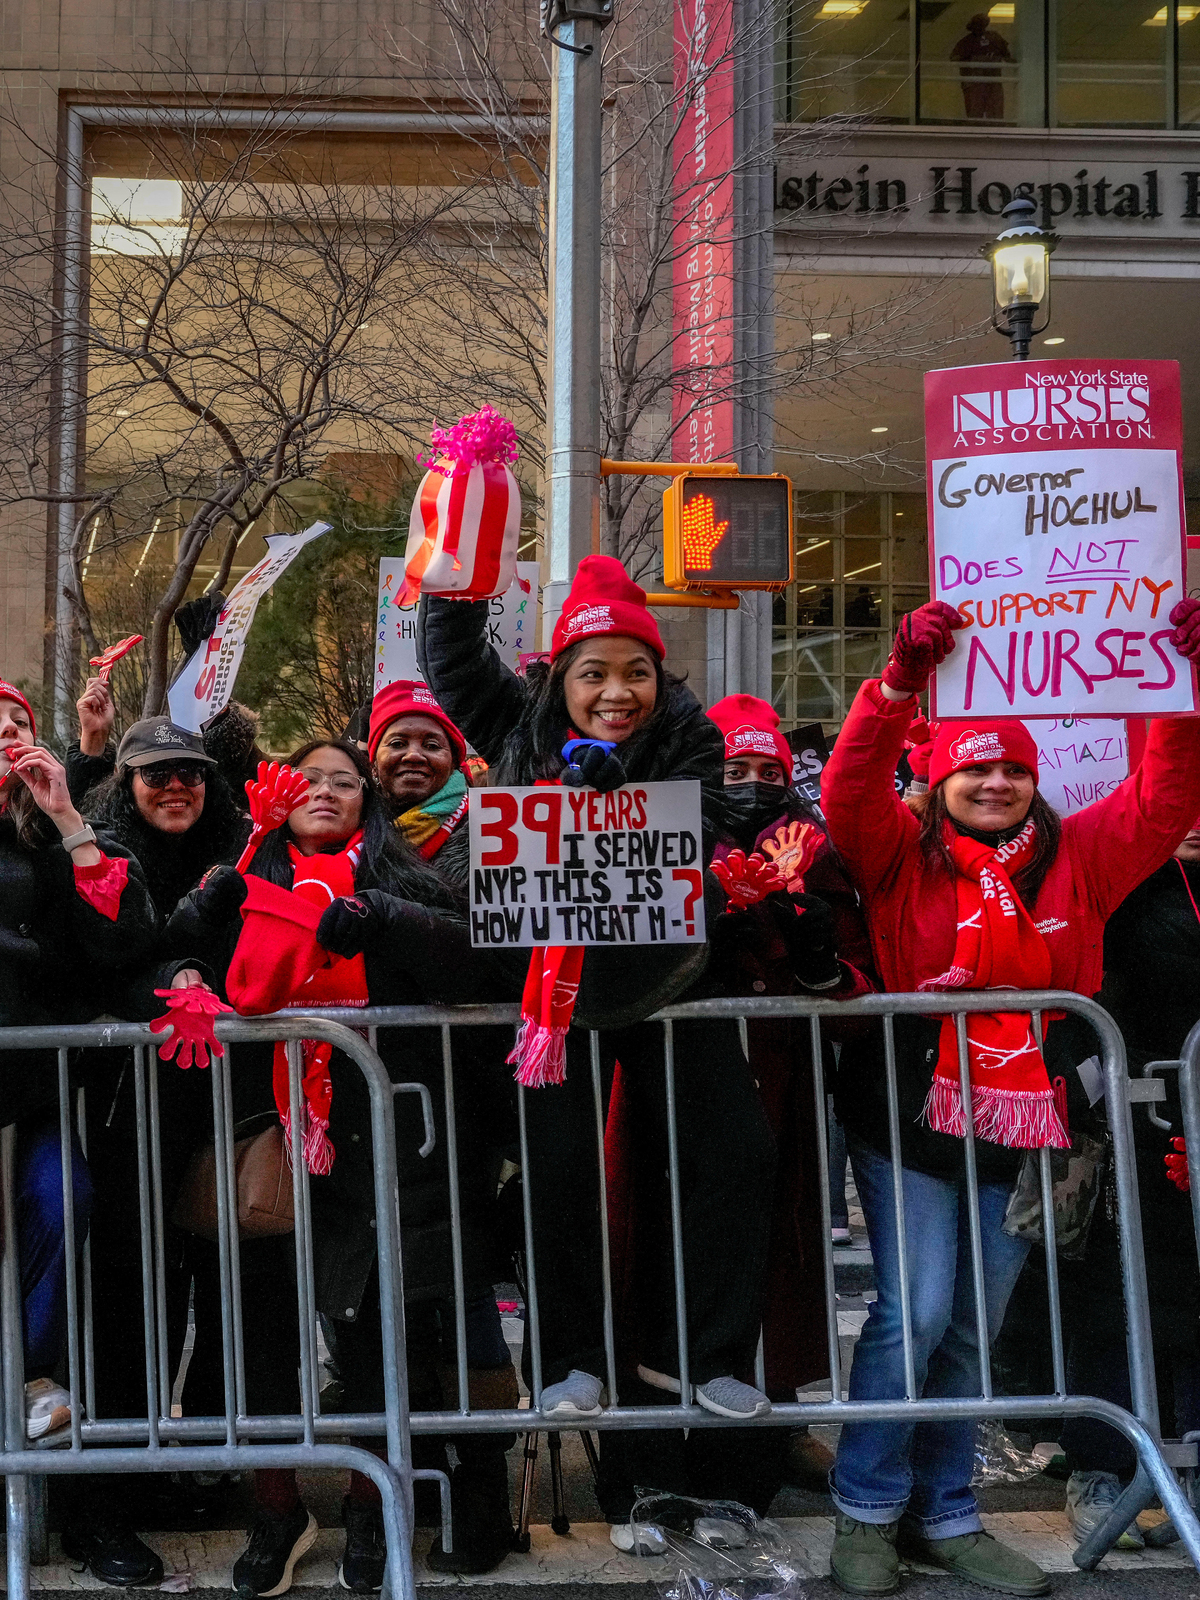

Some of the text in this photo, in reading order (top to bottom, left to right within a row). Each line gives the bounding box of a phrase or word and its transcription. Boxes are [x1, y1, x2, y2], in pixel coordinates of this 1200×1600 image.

[929, 166, 1163, 230] Hospital
[1025, 369, 1148, 388] New York State
[953, 385, 1150, 432] NURSES
[953, 424, 1152, 448] ASSOCIATION
[1025, 486, 1157, 536] HOCHUL
[939, 540, 1139, 591] DOES NOT
[569, 609, 610, 628] NURSES
[958, 576, 1173, 629] SUPPORT NY
[209, 642, 228, 717] HIDING
[964, 628, 1176, 710] NURSES
[734, 734, 774, 743] NURSES
[957, 736, 998, 754] NURSES
[1037, 738, 1127, 770] AMAZI
[480, 789, 647, 866] 39 YEARS
[563, 830, 697, 869] I SERVED
[533, 869, 612, 904] THIS
[625, 868, 664, 903] IS
[471, 904, 641, 944] HOW U TREAT
